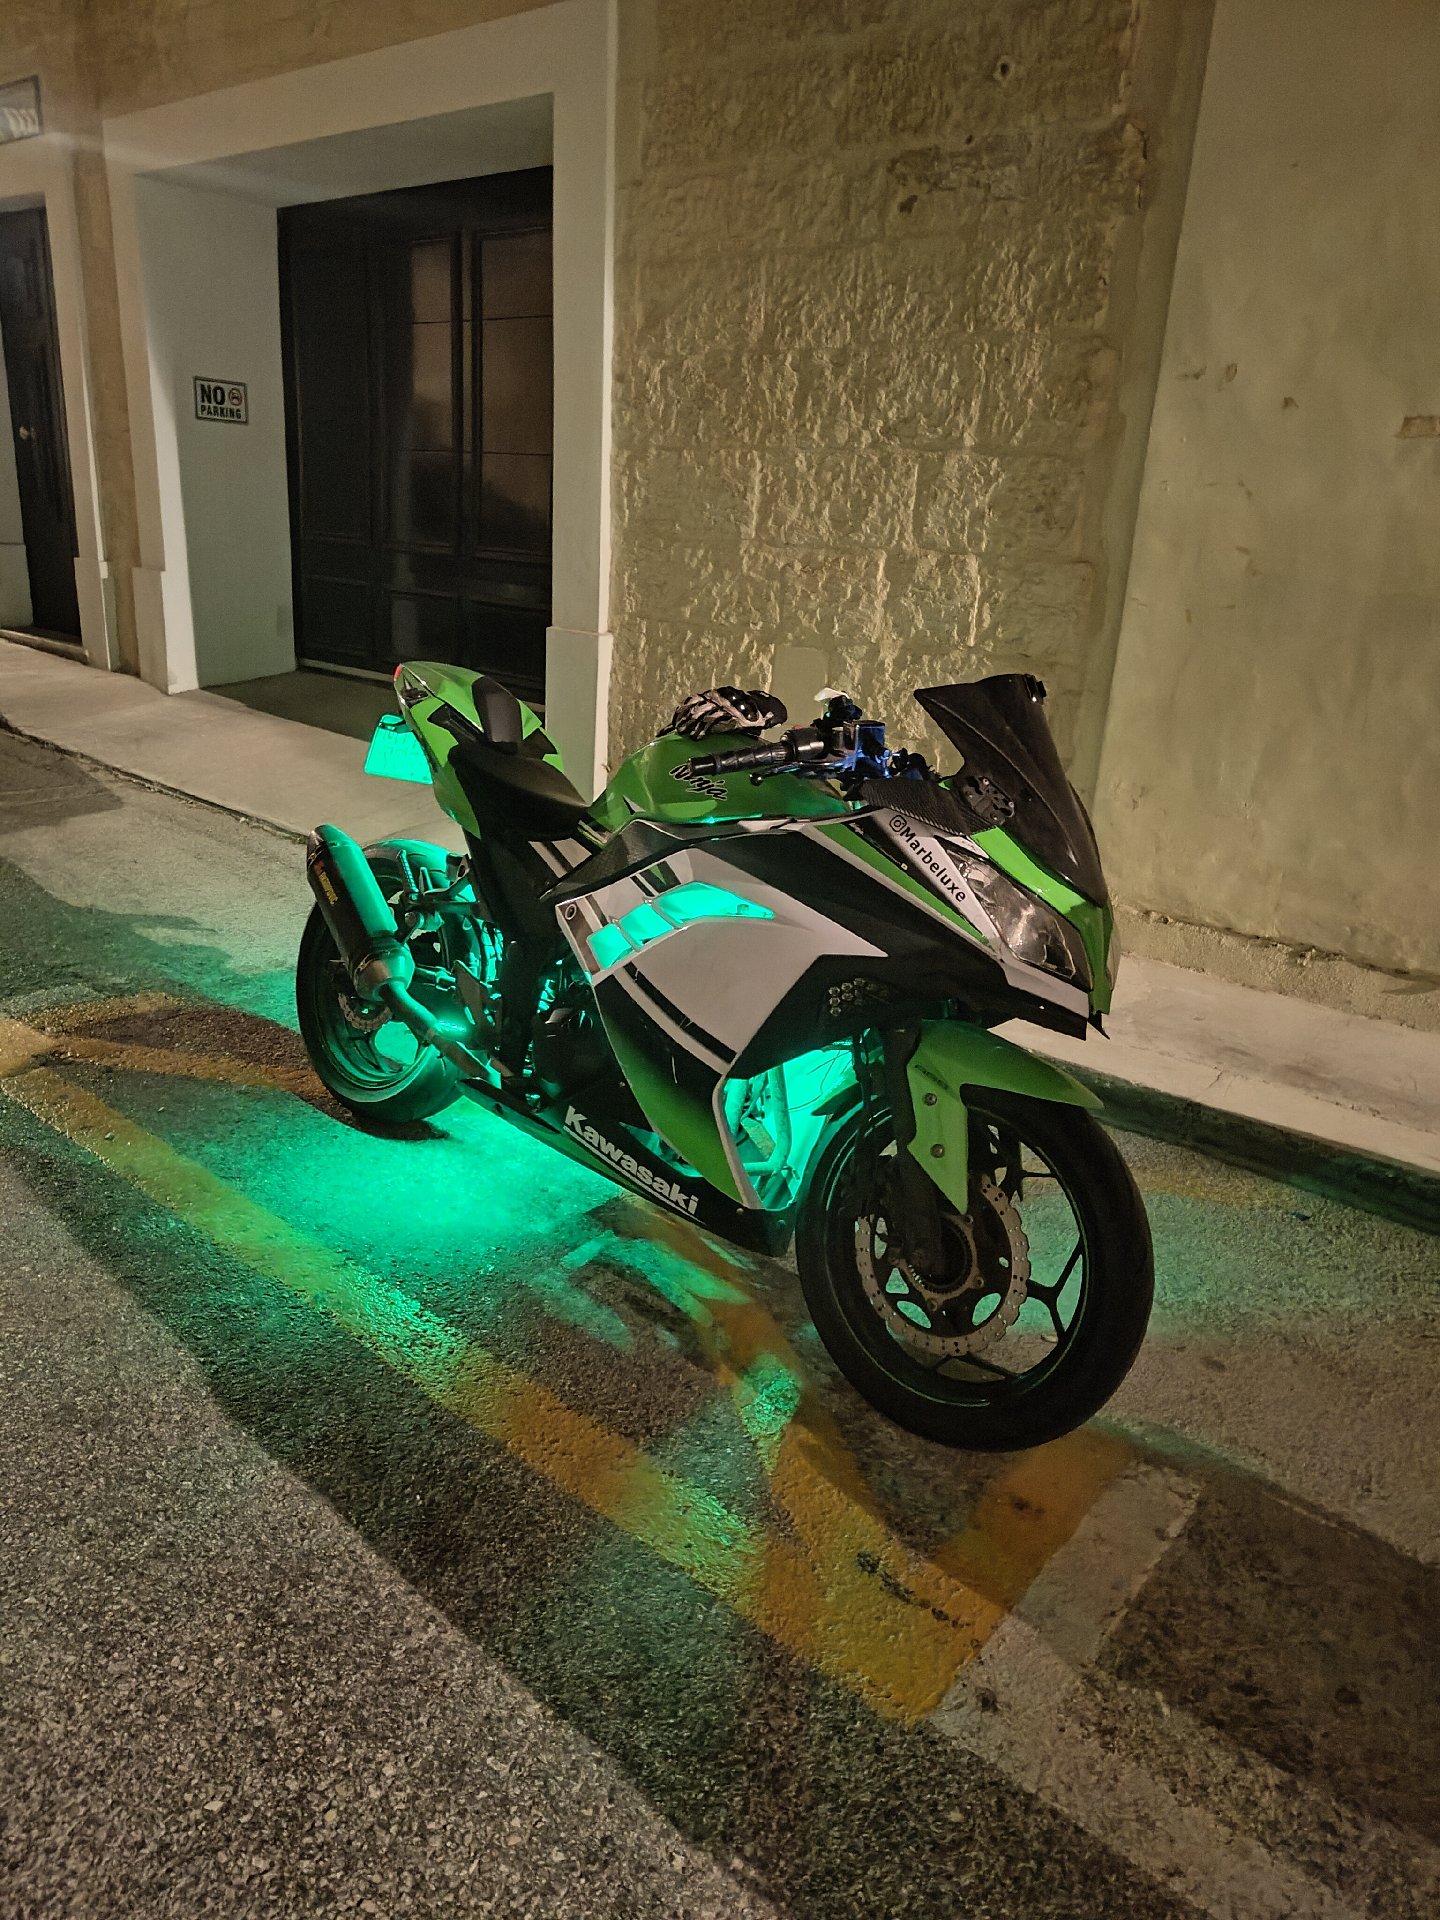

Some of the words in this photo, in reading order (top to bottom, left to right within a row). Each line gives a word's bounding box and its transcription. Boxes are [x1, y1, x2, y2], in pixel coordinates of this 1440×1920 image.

[200, 384, 225, 405] NO
[200, 405, 242, 420] PARKING
[899, 827, 966, 902] Marbeluxe
[564, 1105, 699, 1215] Kawasaki
